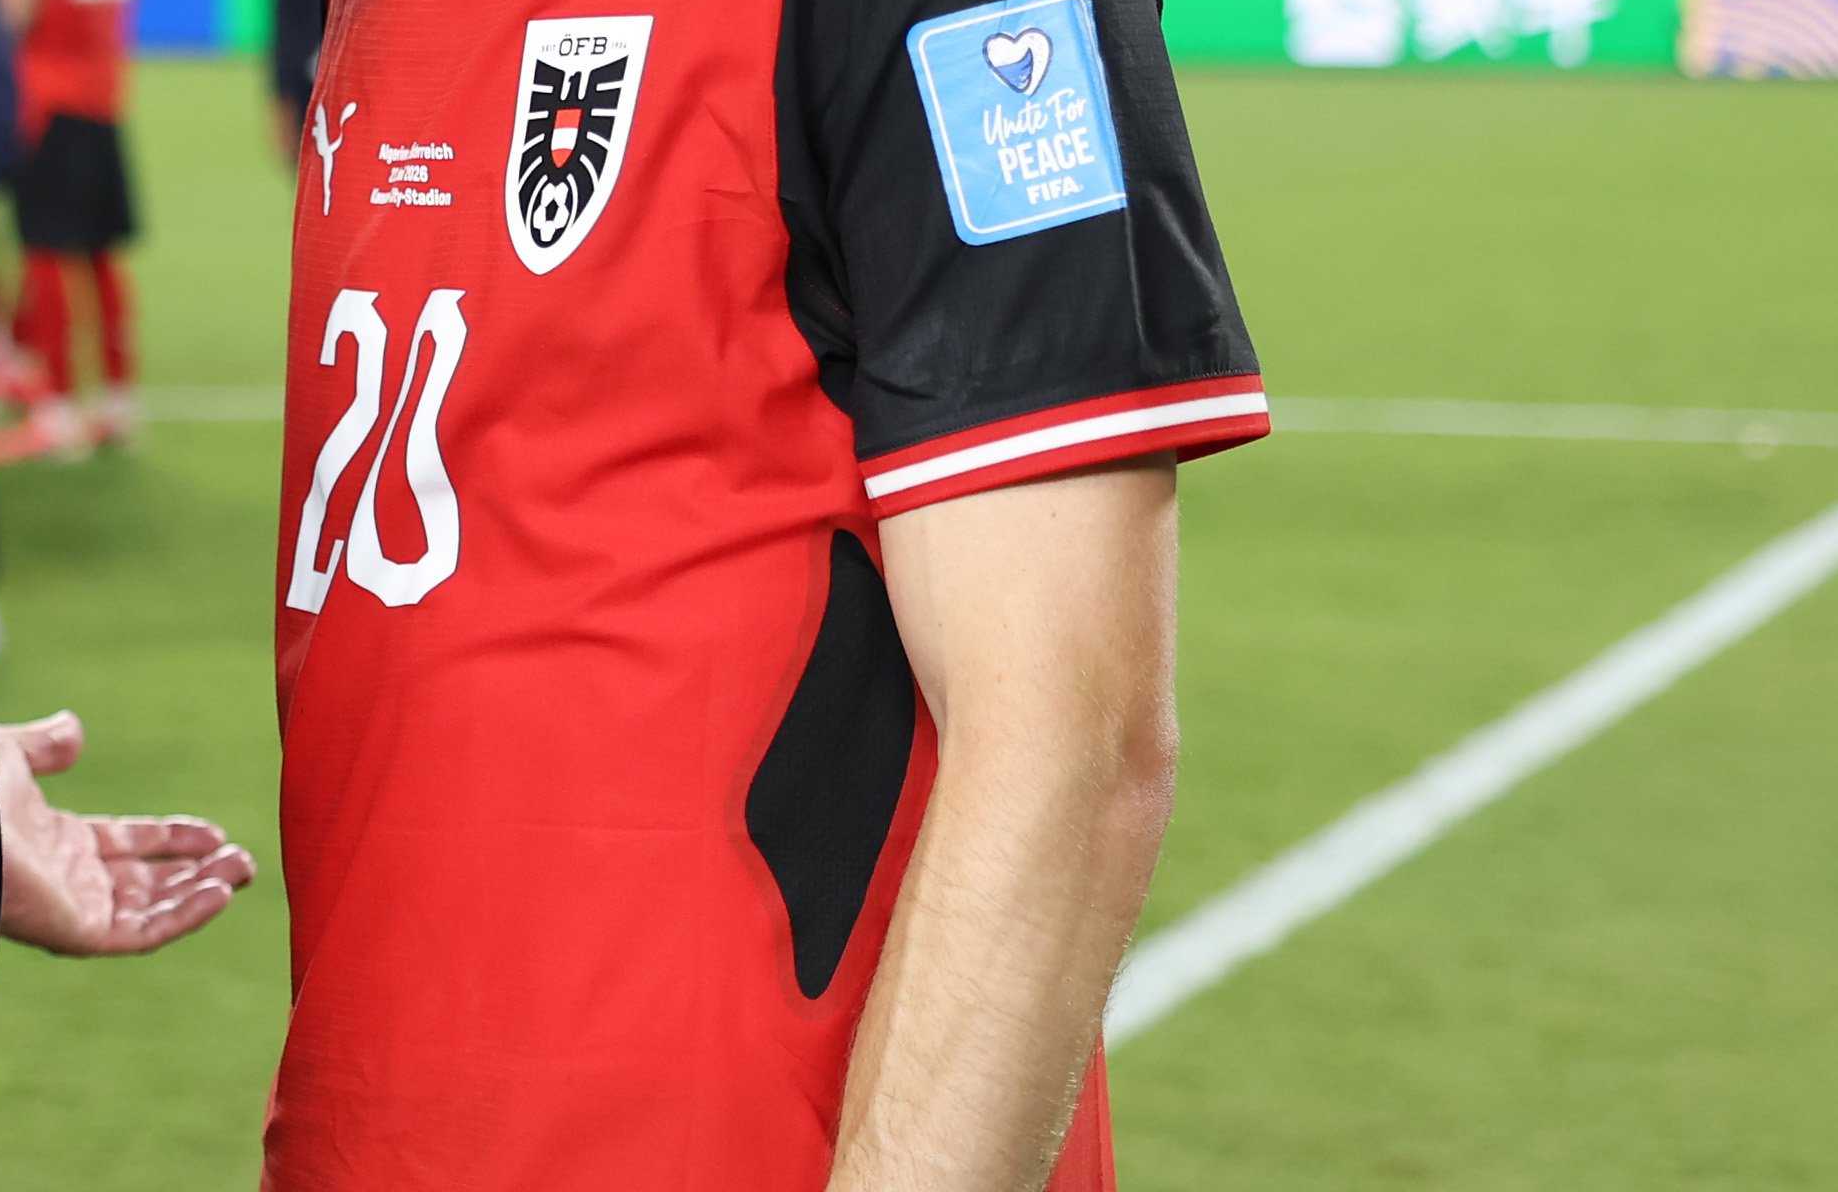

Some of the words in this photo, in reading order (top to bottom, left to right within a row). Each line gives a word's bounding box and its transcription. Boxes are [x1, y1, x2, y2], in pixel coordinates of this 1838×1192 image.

[558, 33, 608, 56] ÖFB
[983, 100, 1049, 148] Unite
[1045, 87, 1087, 130] For
[996, 126, 1096, 186] PEACE
[1025, 175, 1081, 205] FIFA
[285, 288, 468, 615] 20
